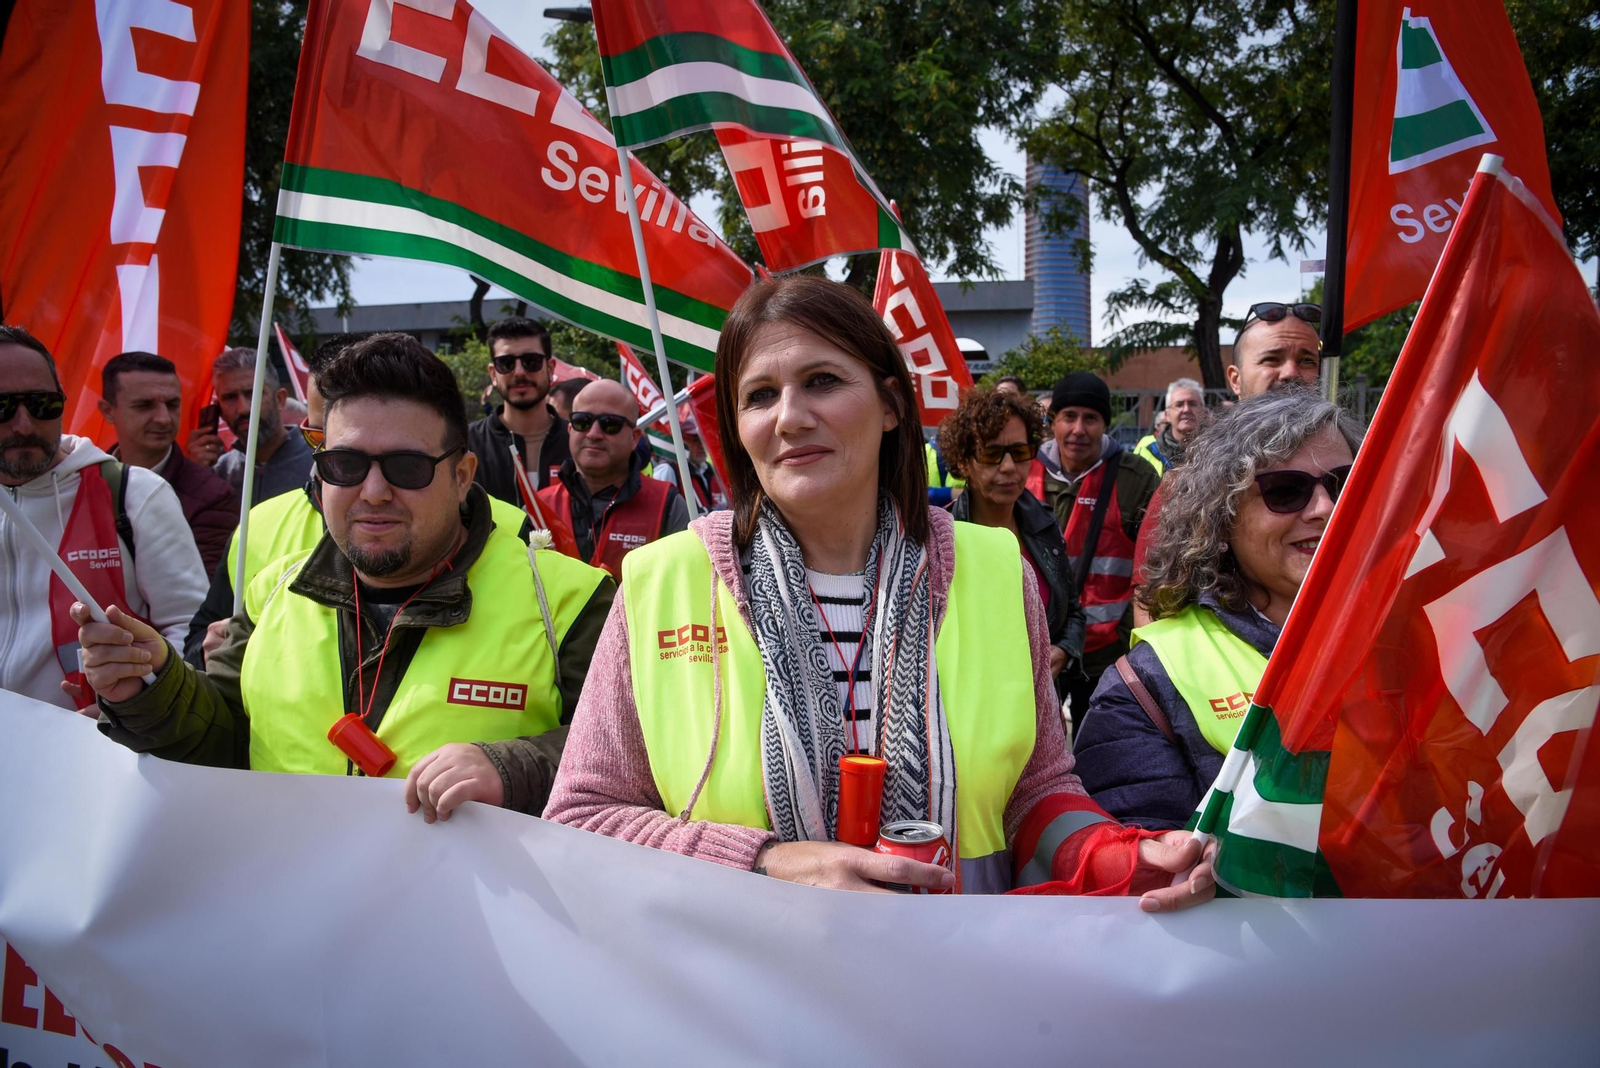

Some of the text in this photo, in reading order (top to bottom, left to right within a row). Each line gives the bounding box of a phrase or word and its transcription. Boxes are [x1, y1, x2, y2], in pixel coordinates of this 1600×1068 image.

[356, 0, 618, 149] CC
[541, 140, 717, 249] Sevilla
[609, 533, 639, 543] CCOO
[67, 548, 109, 562] CCOO
[90, 560, 121, 569] Sevilla
[690, 644, 695, 652] a
[697, 642, 704, 652] la
[453, 683, 523, 705] CCOO
